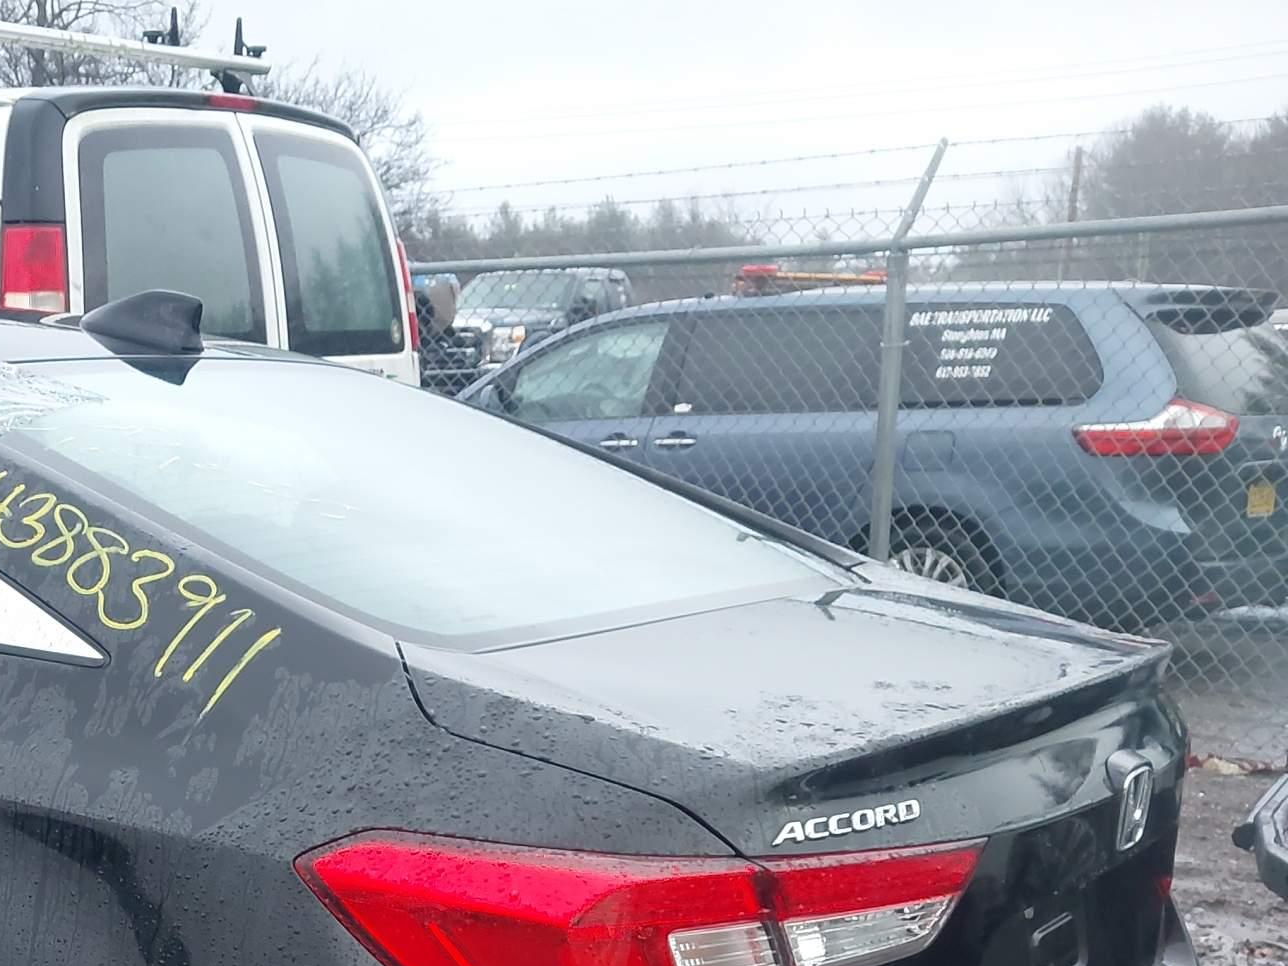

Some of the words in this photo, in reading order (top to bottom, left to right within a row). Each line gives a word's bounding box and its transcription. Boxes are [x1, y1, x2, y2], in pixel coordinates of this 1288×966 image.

[932, 309, 1030, 325] TRANSPORTATION
[1030, 308, 1053, 322] LLC
[771, 799, 921, 846] ACCORD
